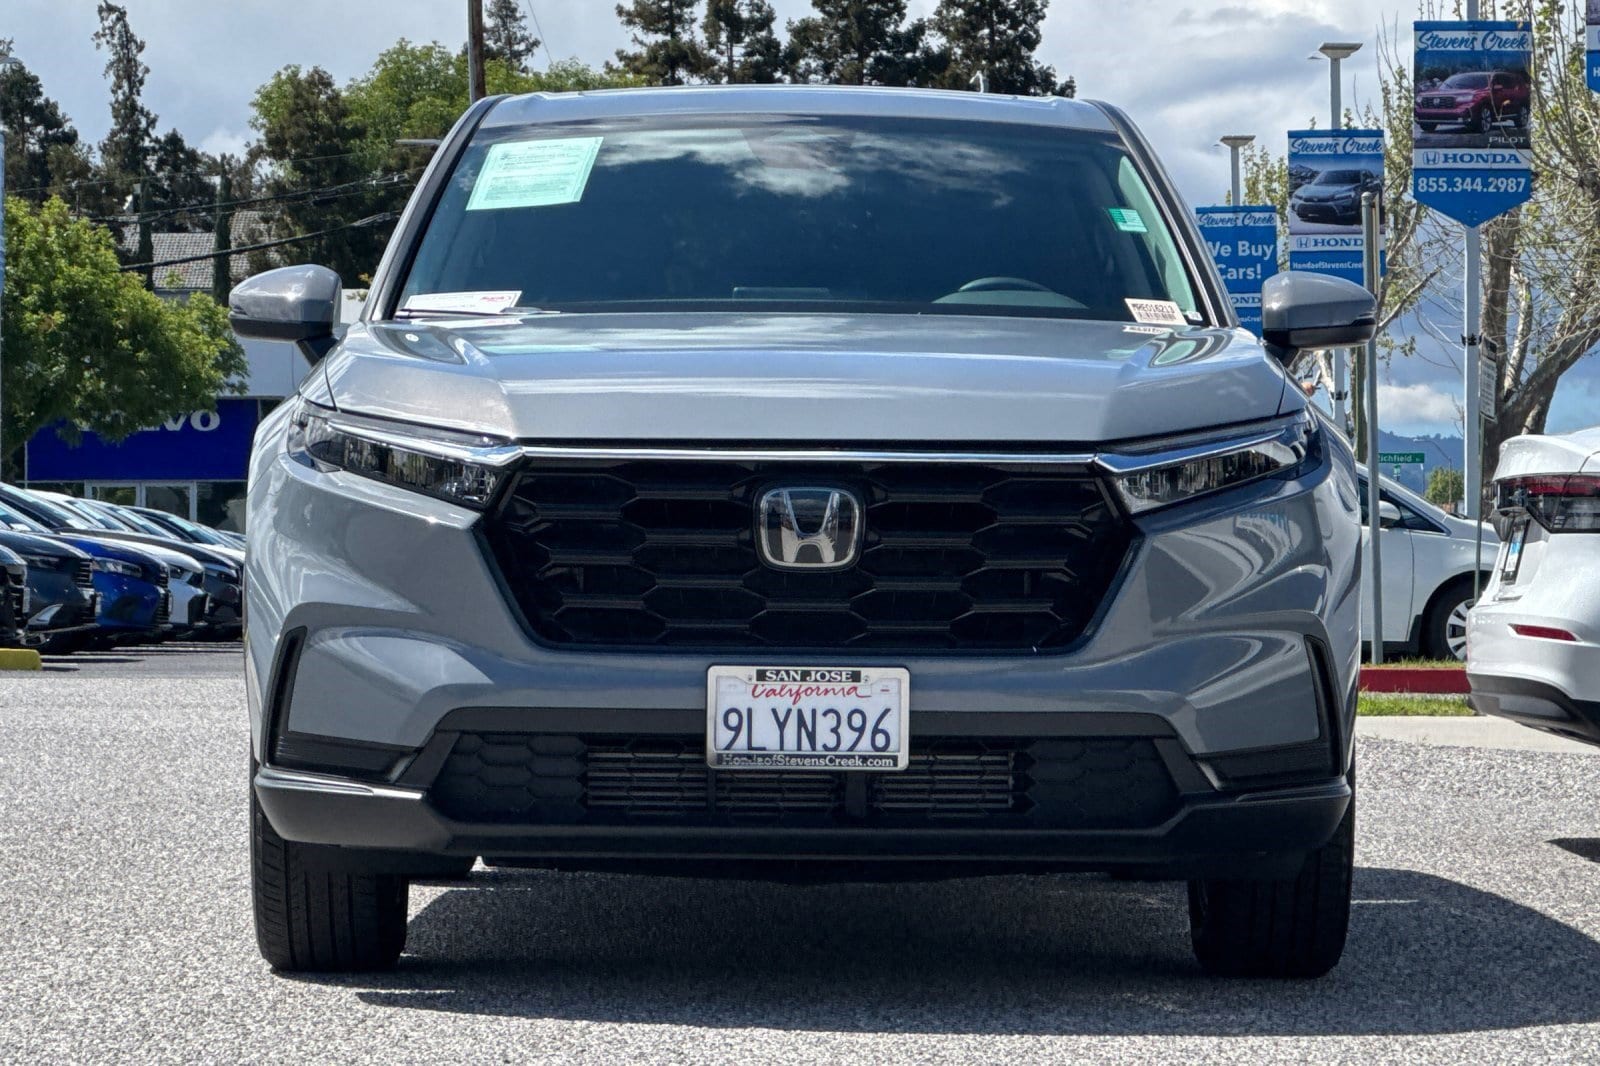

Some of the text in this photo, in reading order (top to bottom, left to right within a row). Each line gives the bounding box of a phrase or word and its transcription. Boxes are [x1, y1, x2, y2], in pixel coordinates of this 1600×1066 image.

[1416, 31, 1529, 51] Stevens Creek
[1291, 137, 1382, 155] Stevens Creek
[1488, 136, 1526, 144] PILOT
[1442, 153, 1522, 164] HONDA
[1417, 177, 1526, 193] 855.344.2987
[1199, 211, 1275, 227] Stevens Creek
[1237, 240, 1274, 261] Buy
[1312, 238, 1363, 247] HOND
[1217, 263, 1262, 280] Cars!
[1231, 296, 1262, 304] OND
[765, 670, 852, 683] SAN JOSE
[751, 683, 872, 705] California
[722, 707, 892, 753] 9LYN396
